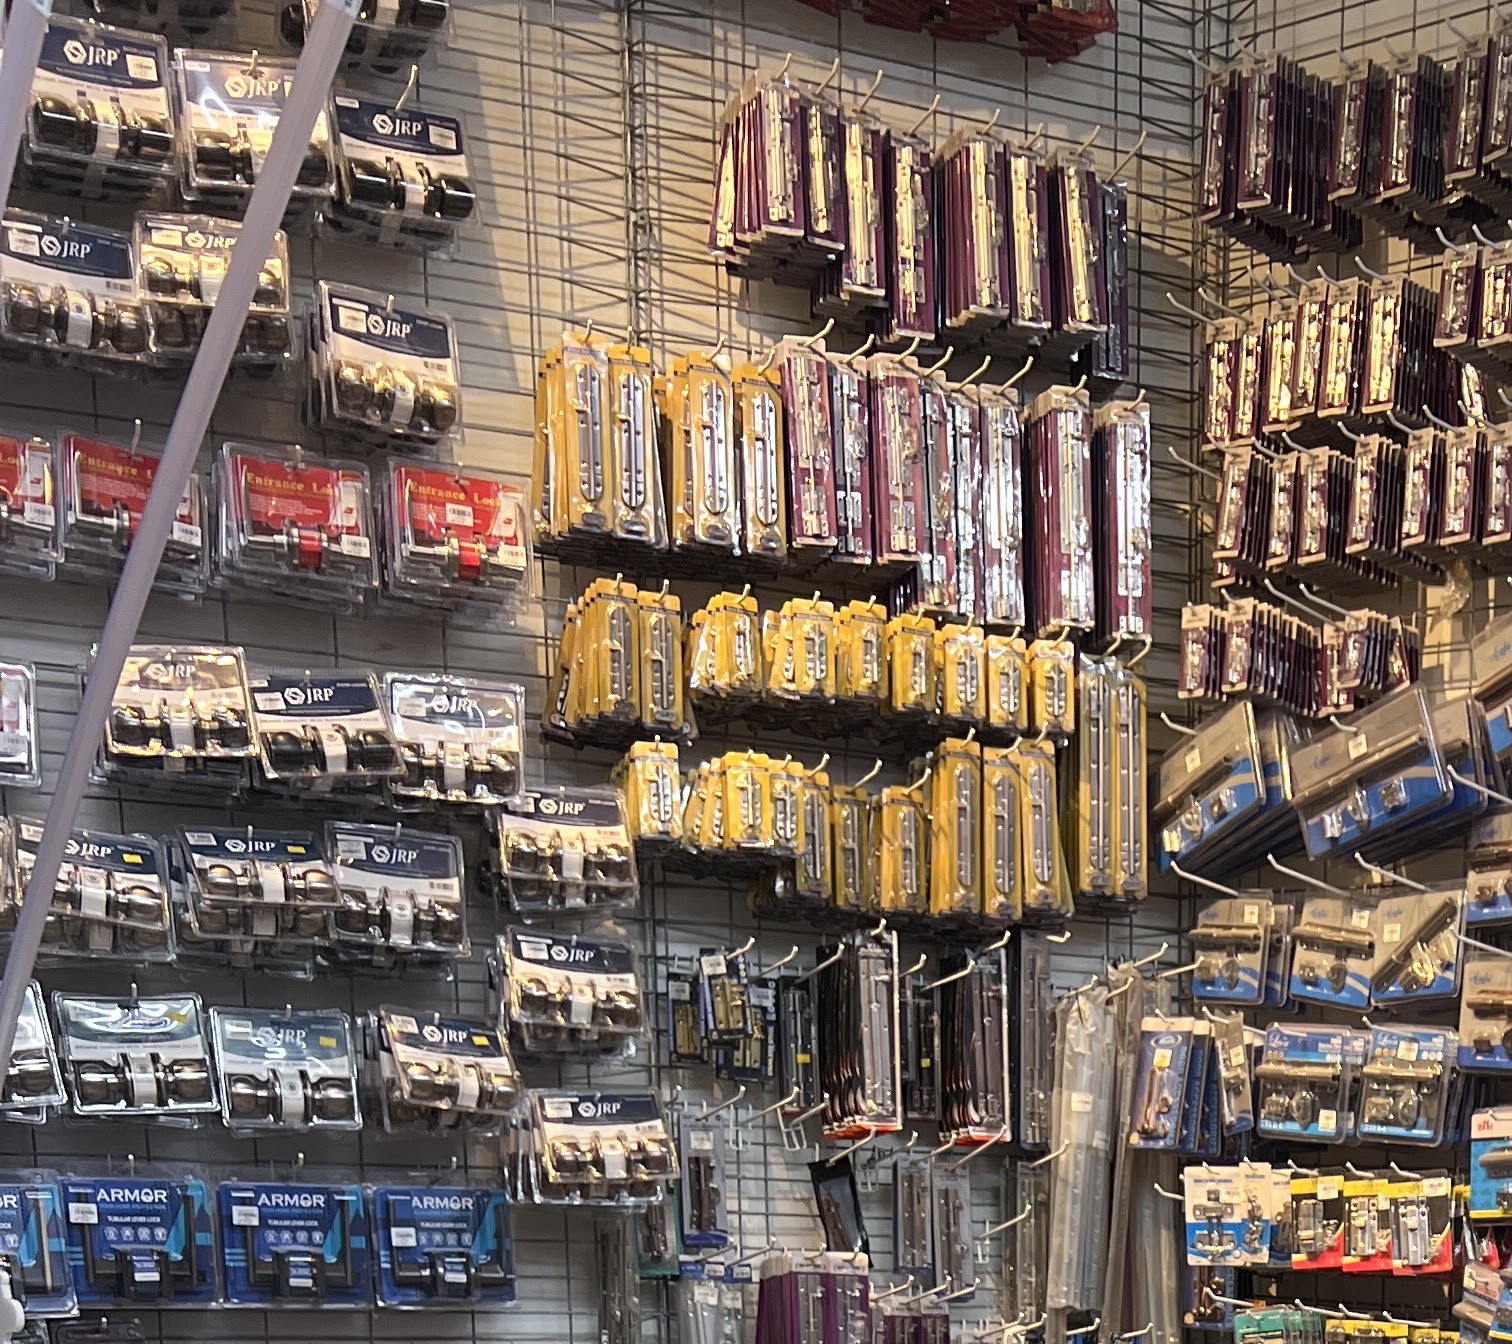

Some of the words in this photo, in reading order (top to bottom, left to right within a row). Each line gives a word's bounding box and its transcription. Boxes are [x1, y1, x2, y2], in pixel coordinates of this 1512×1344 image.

[88, 50, 118, 66] JRP
[392, 117, 424, 136] JRP
[61, 242, 90, 258] JRP
[384, 320, 412, 336] JRP
[305, 687, 335, 703] JRP
[557, 800, 585, 815] JRP
[81, 842, 111, 856] JRP
[248, 839, 276, 854] JRP
[390, 848, 418, 863] JRP
[569, 949, 595, 962] JRP
[95, 1188, 168, 1204] ARMOR
[257, 1193, 325, 1208] ARMOR
[411, 1195, 474, 1211] ARMOR
